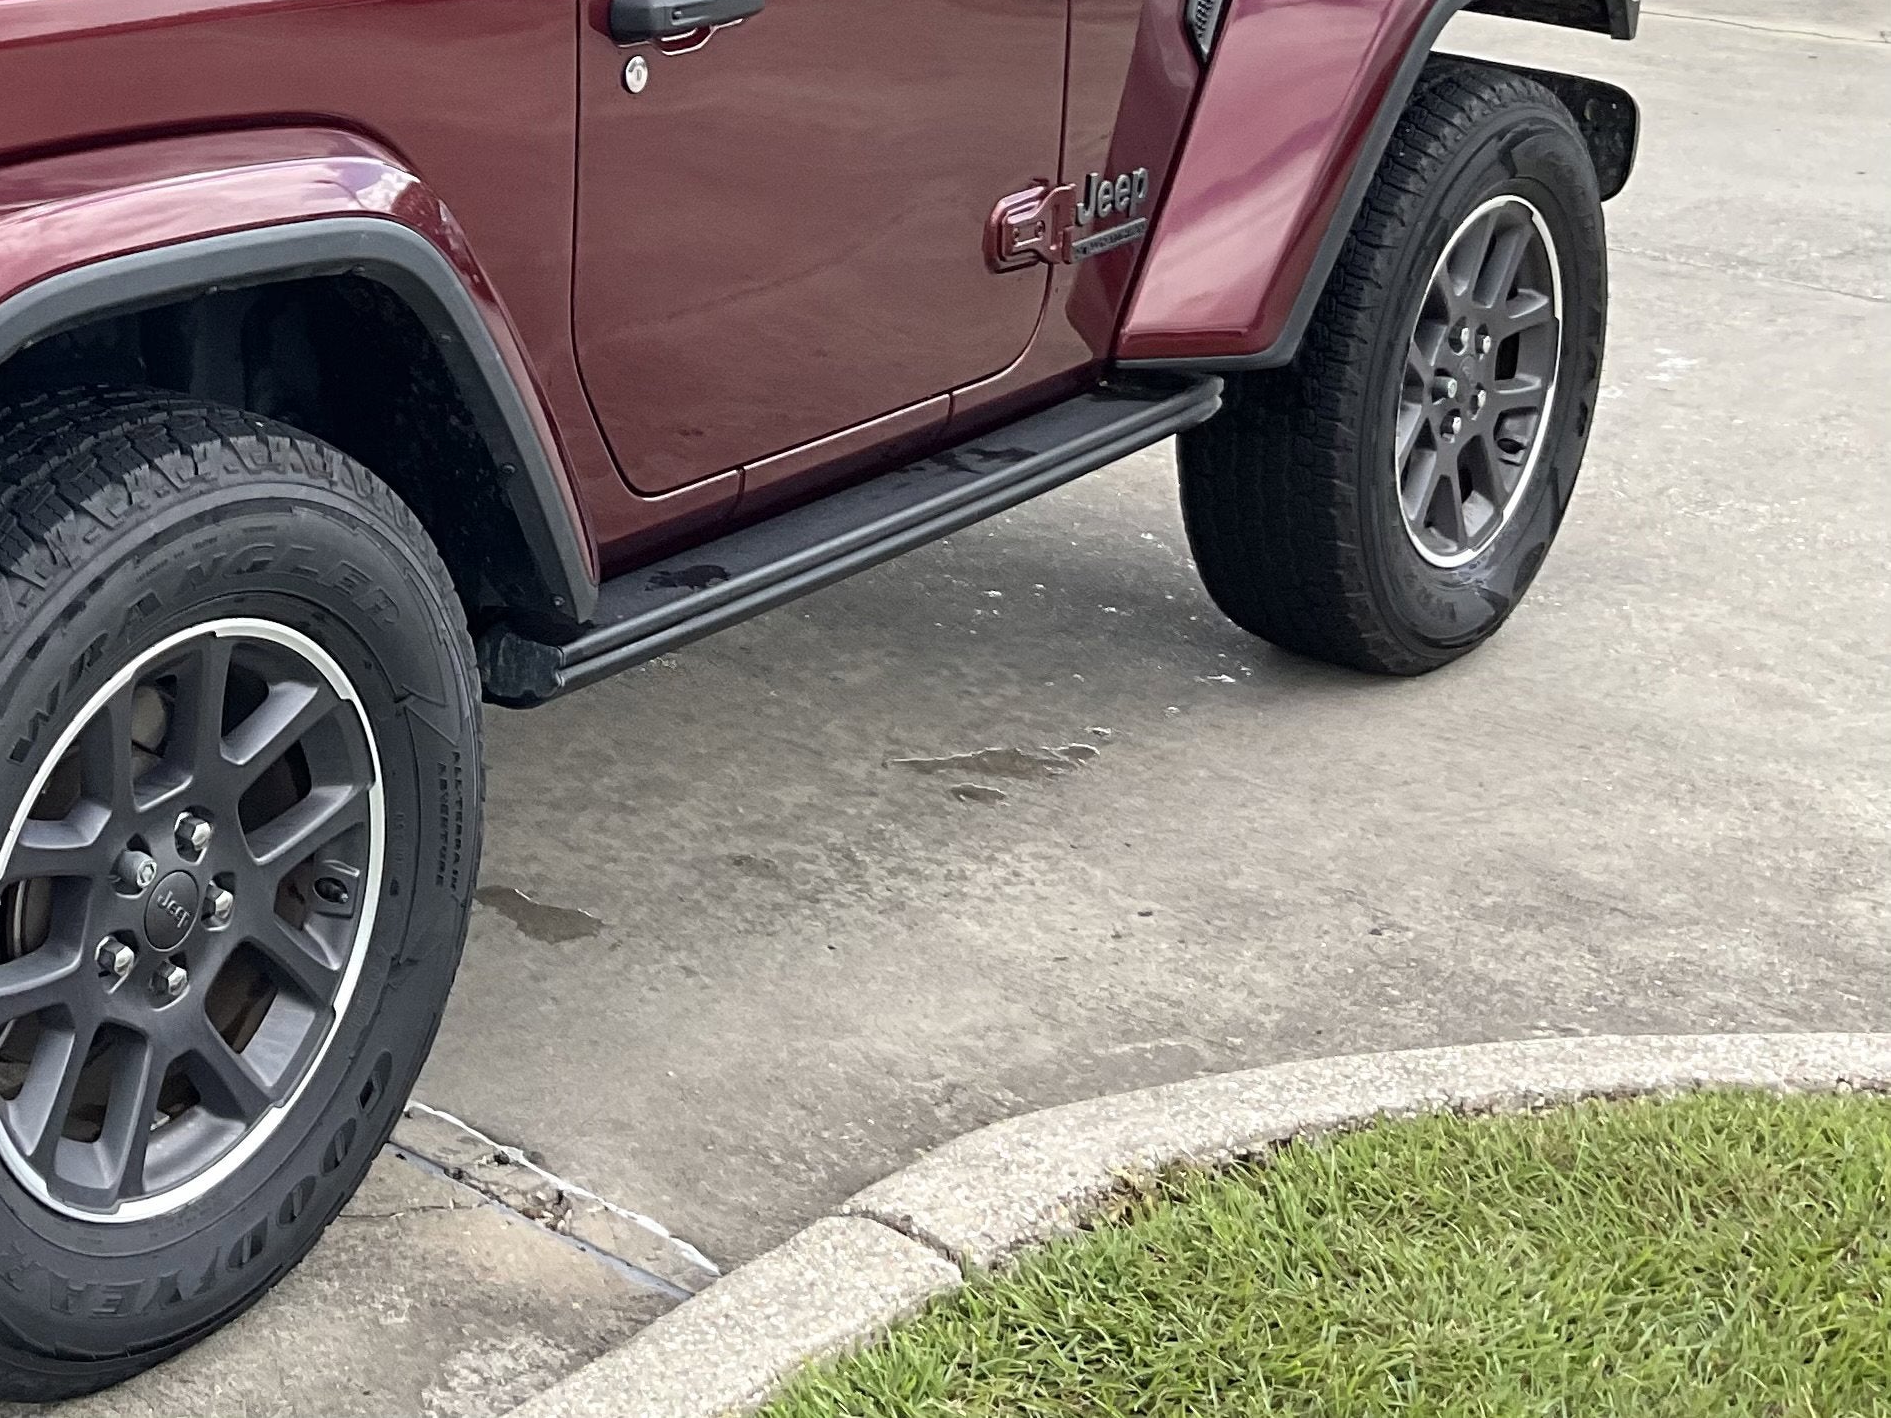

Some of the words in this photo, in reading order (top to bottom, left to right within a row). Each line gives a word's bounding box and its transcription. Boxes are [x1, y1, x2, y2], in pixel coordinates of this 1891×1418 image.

[1076, 167, 1148, 225] Jeep
[9, 542, 400, 764] WRANGLER
[156, 890, 190, 928] Jeep
